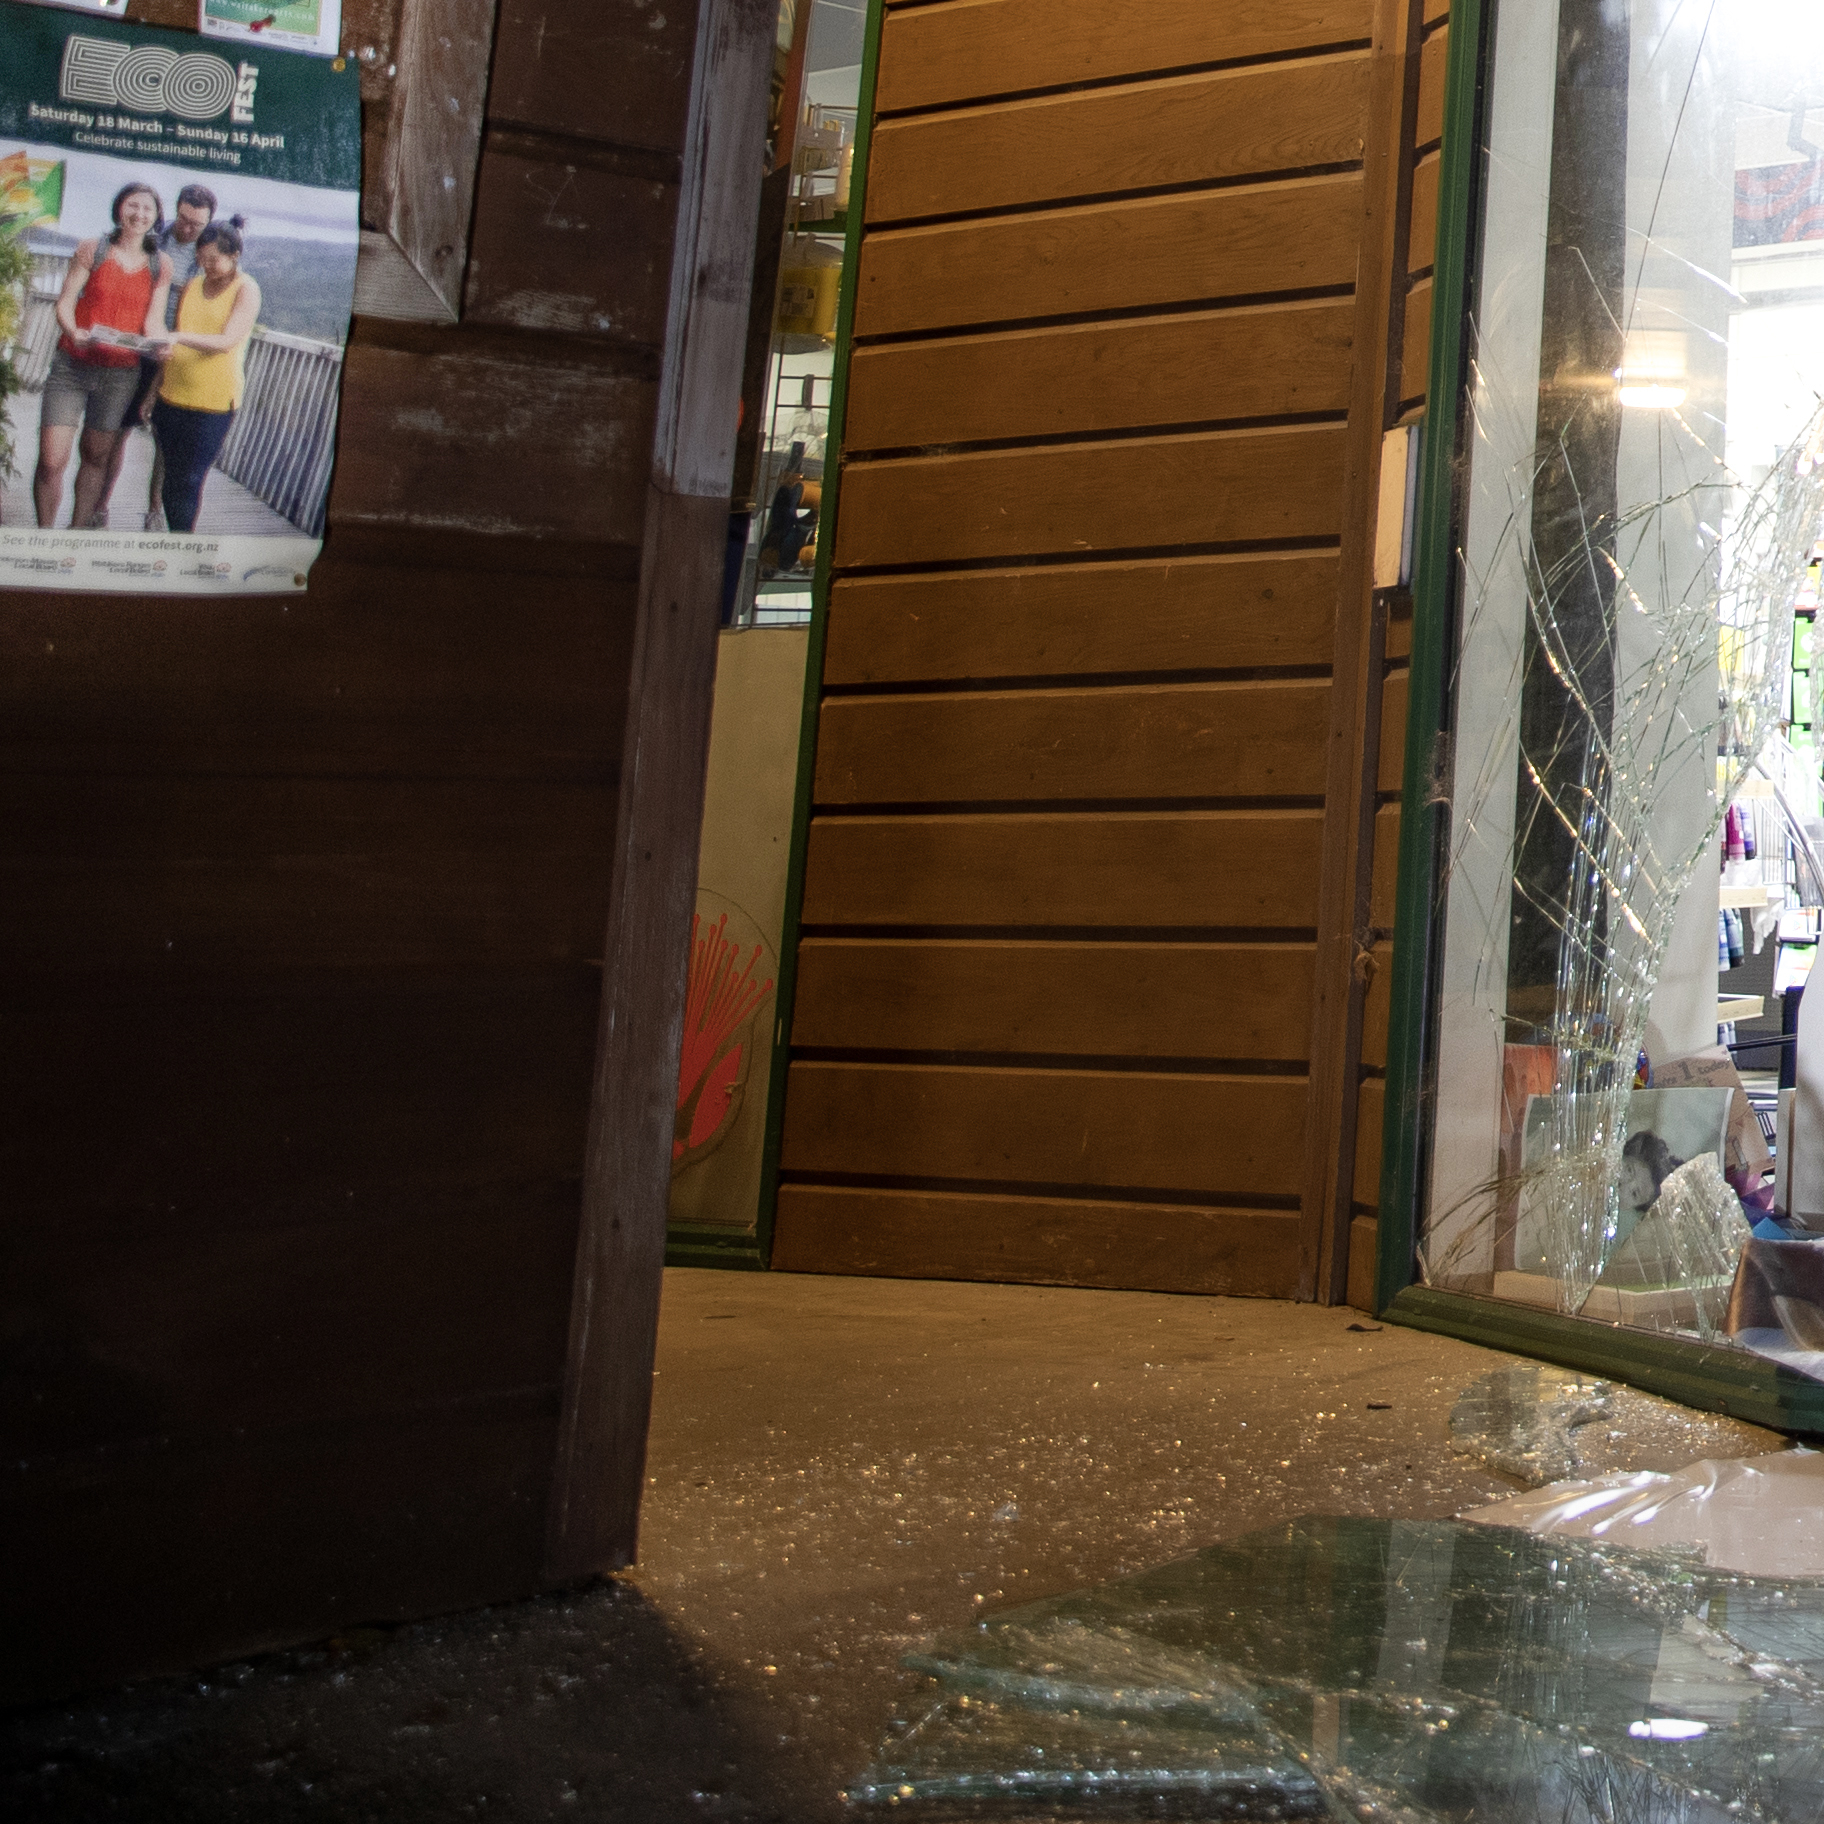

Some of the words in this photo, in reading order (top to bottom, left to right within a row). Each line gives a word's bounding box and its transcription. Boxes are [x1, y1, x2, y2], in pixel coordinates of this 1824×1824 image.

[61, 34, 238, 119] ECO
[233, 61, 260, 123] FEST
[29, 103, 94, 128] Saturday
[97, 115, 115, 128] 18
[118, 117, 163, 135] March
[177, 124, 229, 144] Sunday
[232, 130, 249, 144] 16
[251, 132, 285, 150] April
[75, 130, 134, 150] Celebrate
[136, 139, 207, 159] sustainable
[209, 146, 242, 165] living
[2, 534, 26, 546] See
[28, 534, 49, 548] the
[51, 537, 121, 556] programme
[123, 539, 137, 550] at
[138, 539, 220, 555] ecofest.org.nz
